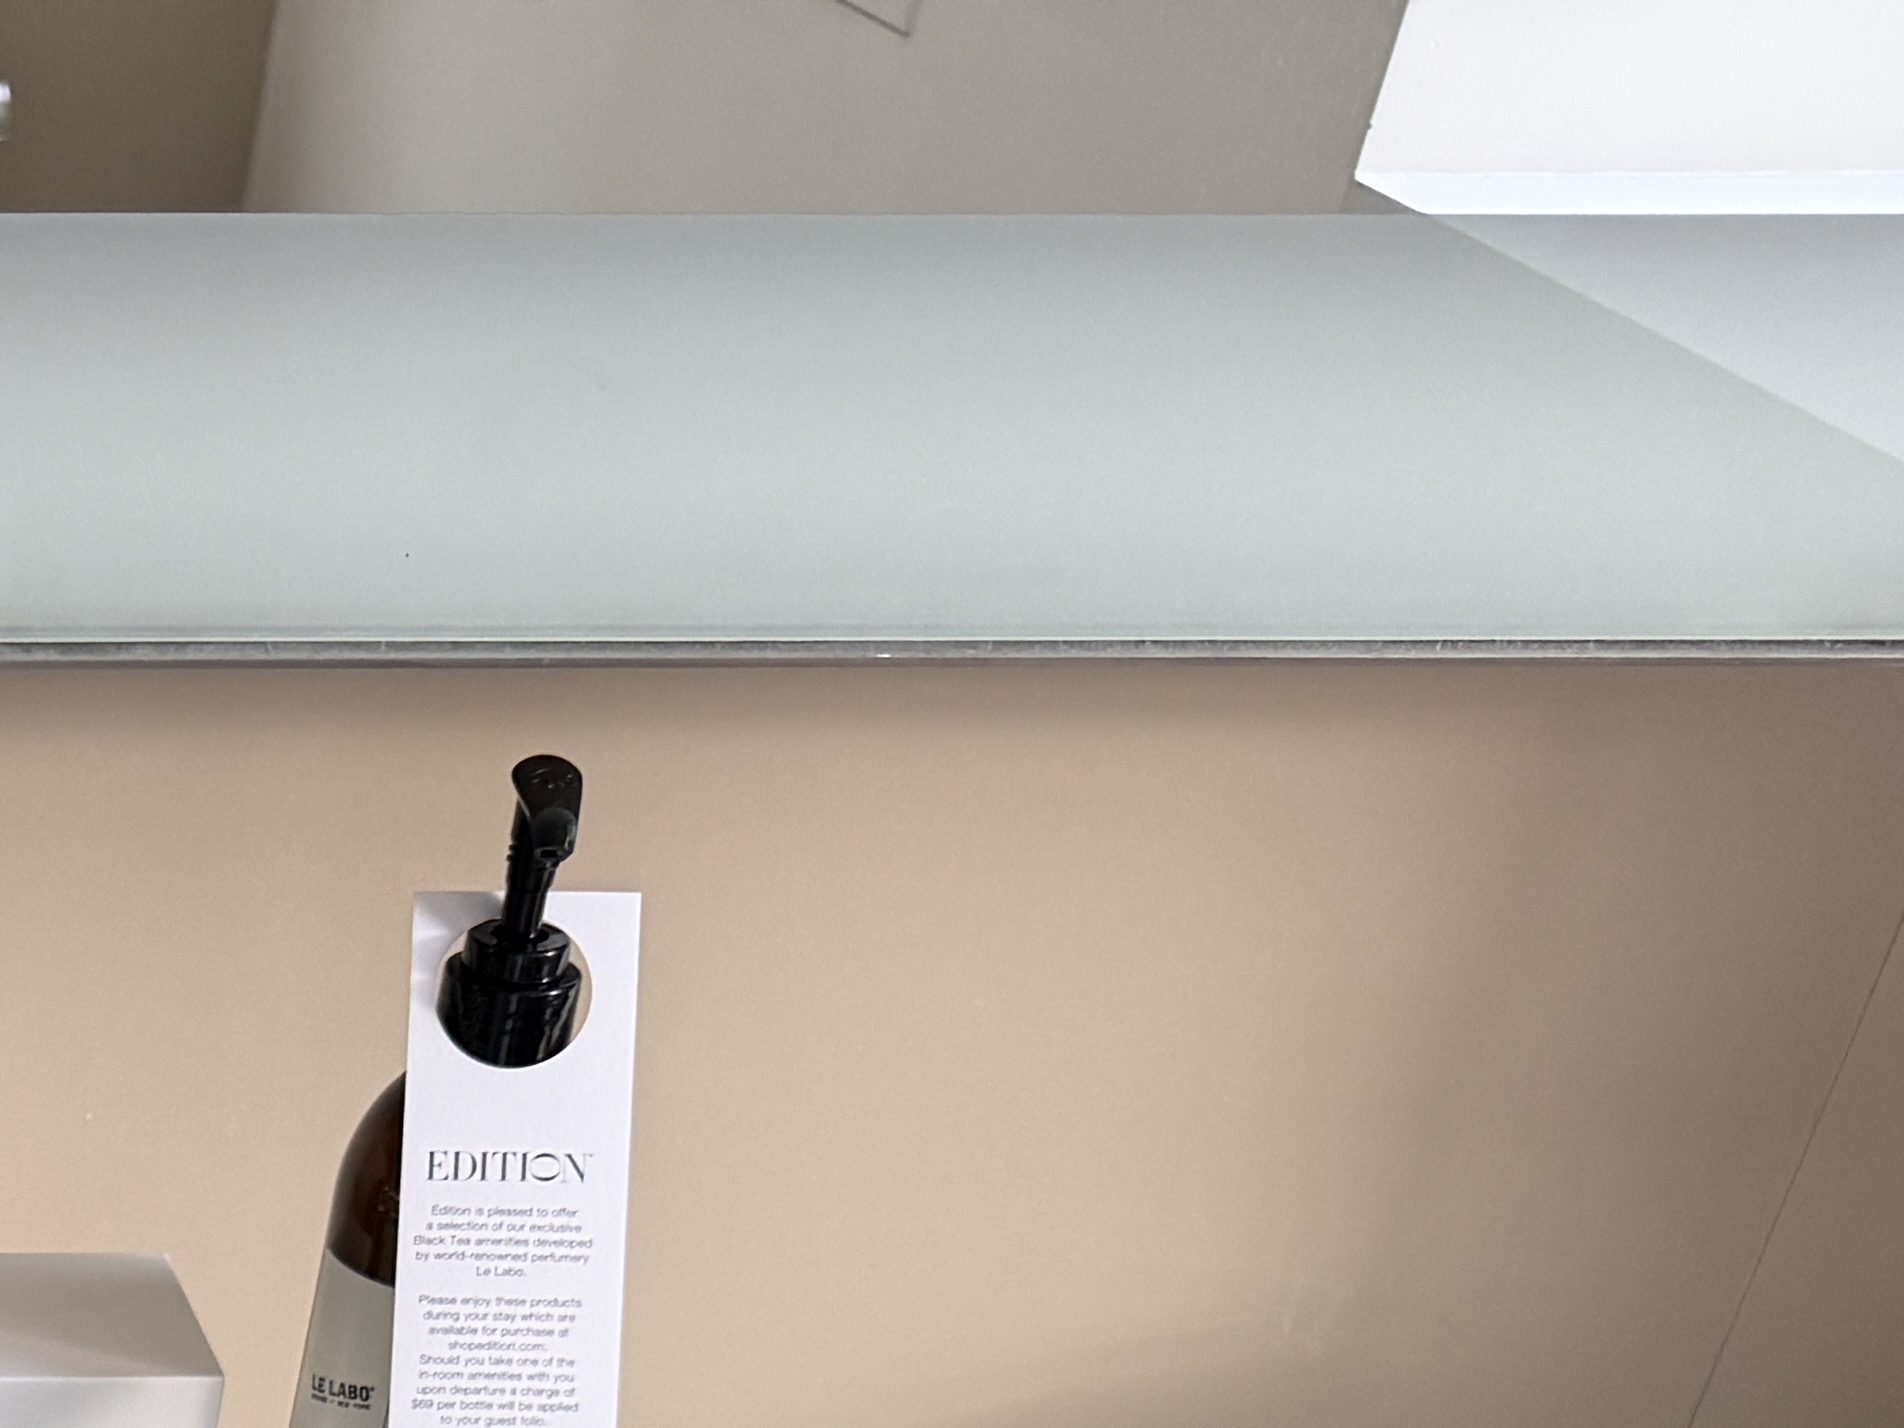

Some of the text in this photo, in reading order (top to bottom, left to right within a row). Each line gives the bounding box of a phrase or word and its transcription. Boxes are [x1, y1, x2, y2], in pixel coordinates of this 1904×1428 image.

[425, 1150, 589, 1184] EDITION
[431, 1204, 578, 1218] Edition is pleased to offer
[425, 1221, 582, 1233] a selection of our exclusive
[413, 1235, 593, 1249] Black Tea amenities developed
[415, 1251, 430, 1262] by
[476, 1266, 491, 1276] Le
[418, 1294, 582, 1309] Please enjoy these products
[423, 1310, 576, 1323] during your stay which are
[428, 1325, 569, 1338] available for purchase at
[419, 1354, 575, 1367] Should you take one of the
[467, 1370, 522, 1382] amenities
[526, 1371, 550, 1382] with
[553, 1374, 574, 1384] you
[312, 1374, 326, 1394] LE
[329, 1380, 372, 1402] LABO
[416, 1386, 447, 1396] upon
[449, 1385, 506, 1396] departure
[520, 1386, 560, 1399] charge
[563, 1387, 575, 1397] of
[436, 1401, 455, 1412] per
[459, 1400, 493, 1411] bottle
[496, 1400, 515, 1411] will
[518, 1401, 533, 1412] be
[440, 1415, 452, 1425] to
[455, 1416, 480, 1426] your
[484, 1415, 517, 1427] guest
